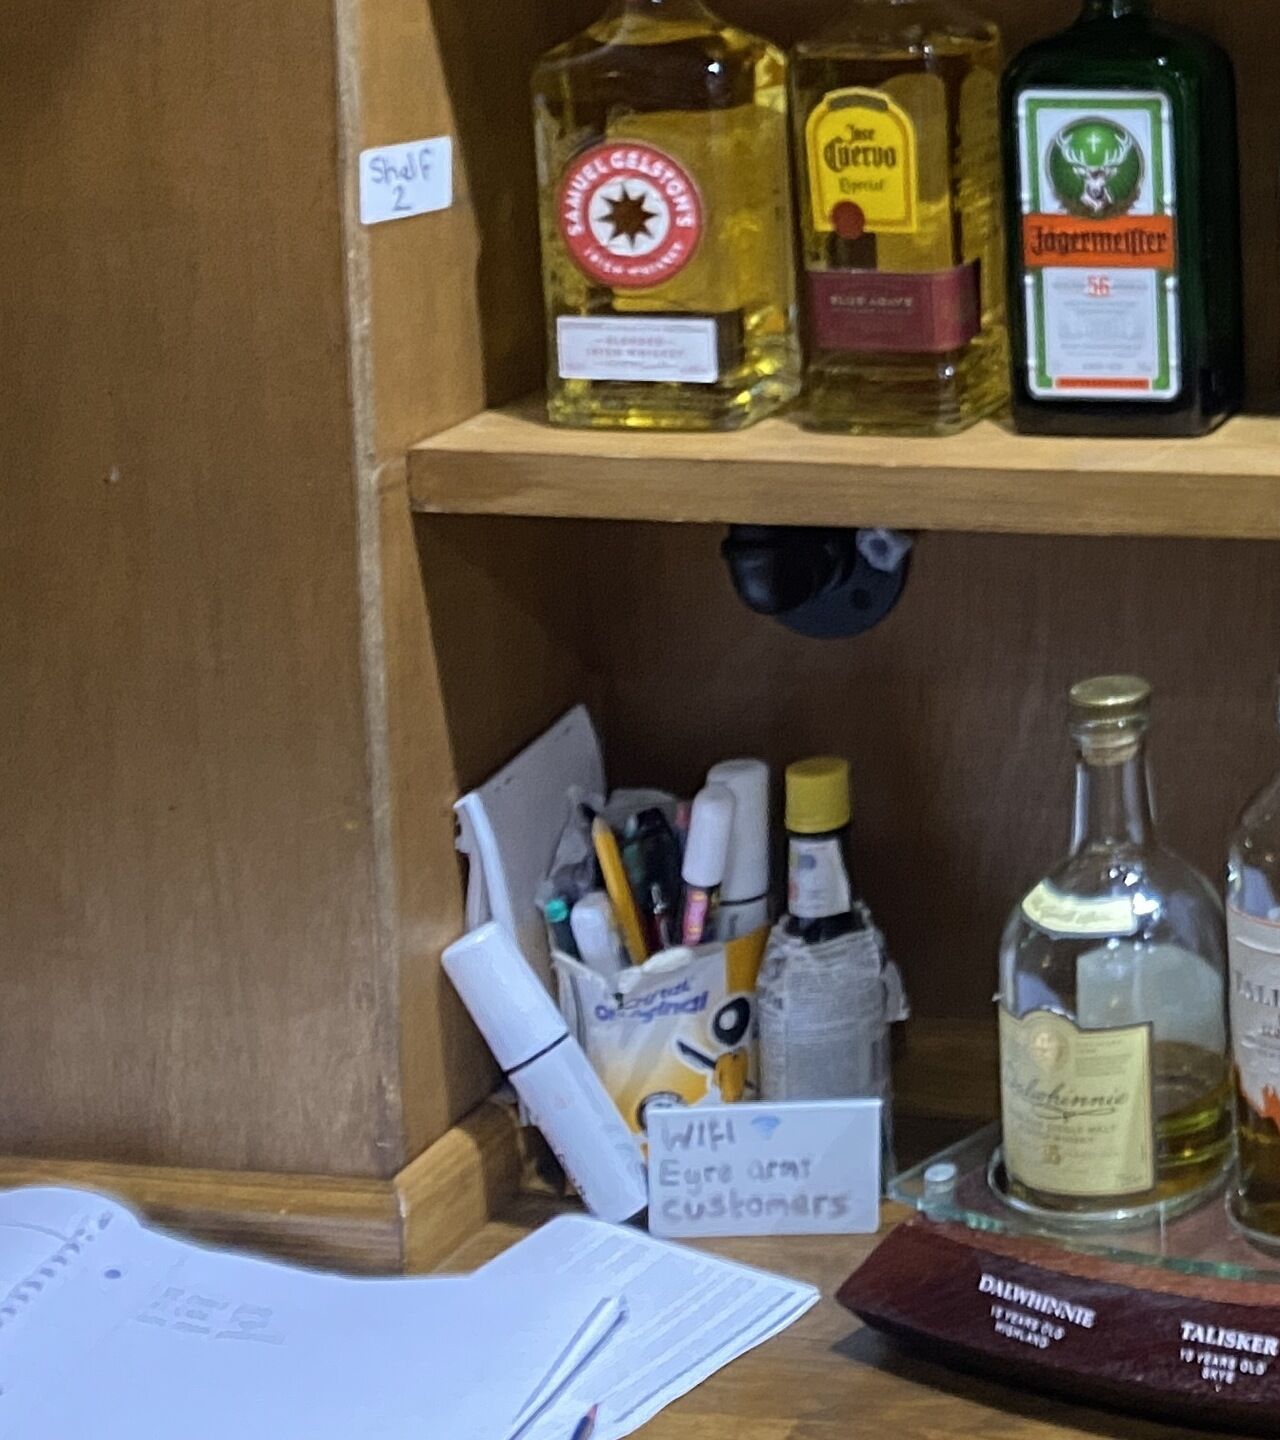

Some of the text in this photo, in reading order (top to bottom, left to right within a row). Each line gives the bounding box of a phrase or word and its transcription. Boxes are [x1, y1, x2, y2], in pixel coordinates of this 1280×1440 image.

[369, 148, 433, 186] Shelf
[823, 135, 897, 173] Cuervo
[390, 183, 413, 212] 2
[564, 158, 611, 236] SAMUEL
[977, 1272, 1098, 1329] DALWHINNIE
[1180, 1320, 1280, 1357] TALISKER
